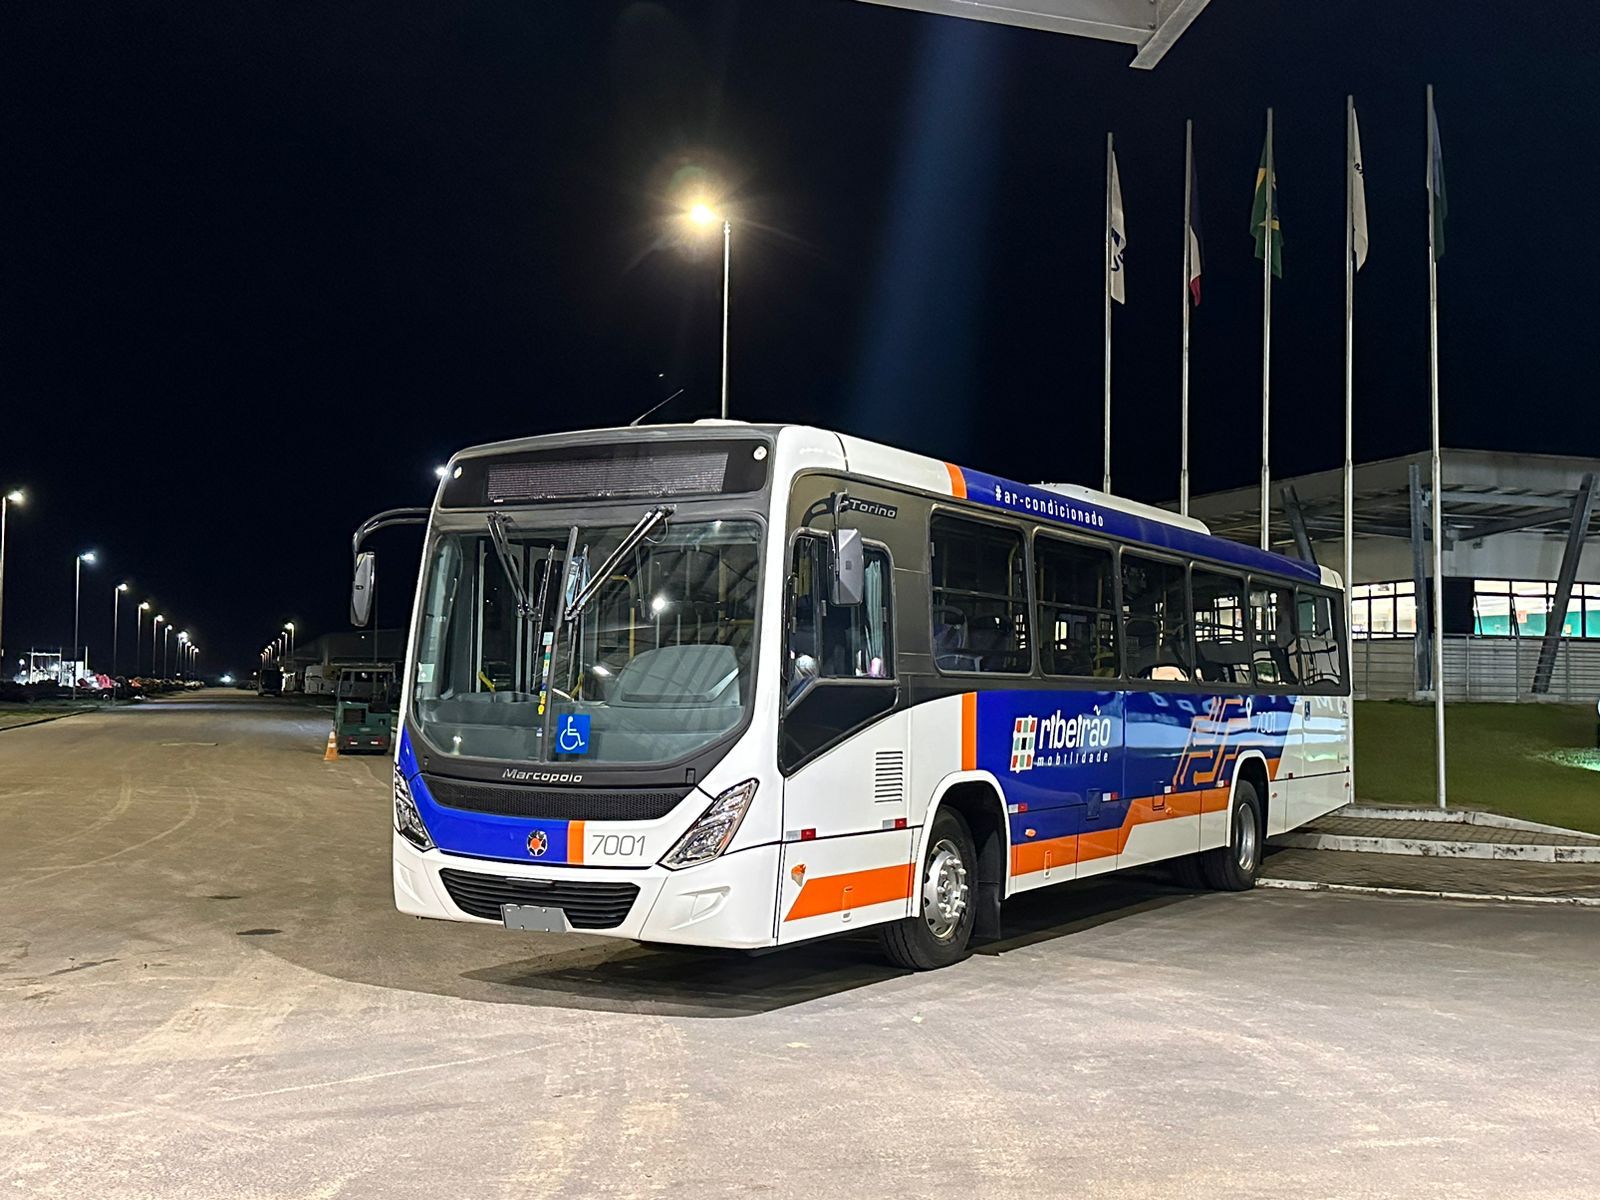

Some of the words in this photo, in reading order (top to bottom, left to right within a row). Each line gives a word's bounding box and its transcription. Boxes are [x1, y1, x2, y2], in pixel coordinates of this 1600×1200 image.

[850, 499, 896, 518] Torino
[995, 485, 1104, 527] #ar-condicionado
[1038, 705, 1111, 750] ribeirão
[1036, 749, 1109, 767] mobilidade
[502, 768, 583, 783] Marcopolo
[591, 834, 646, 856] 7001
